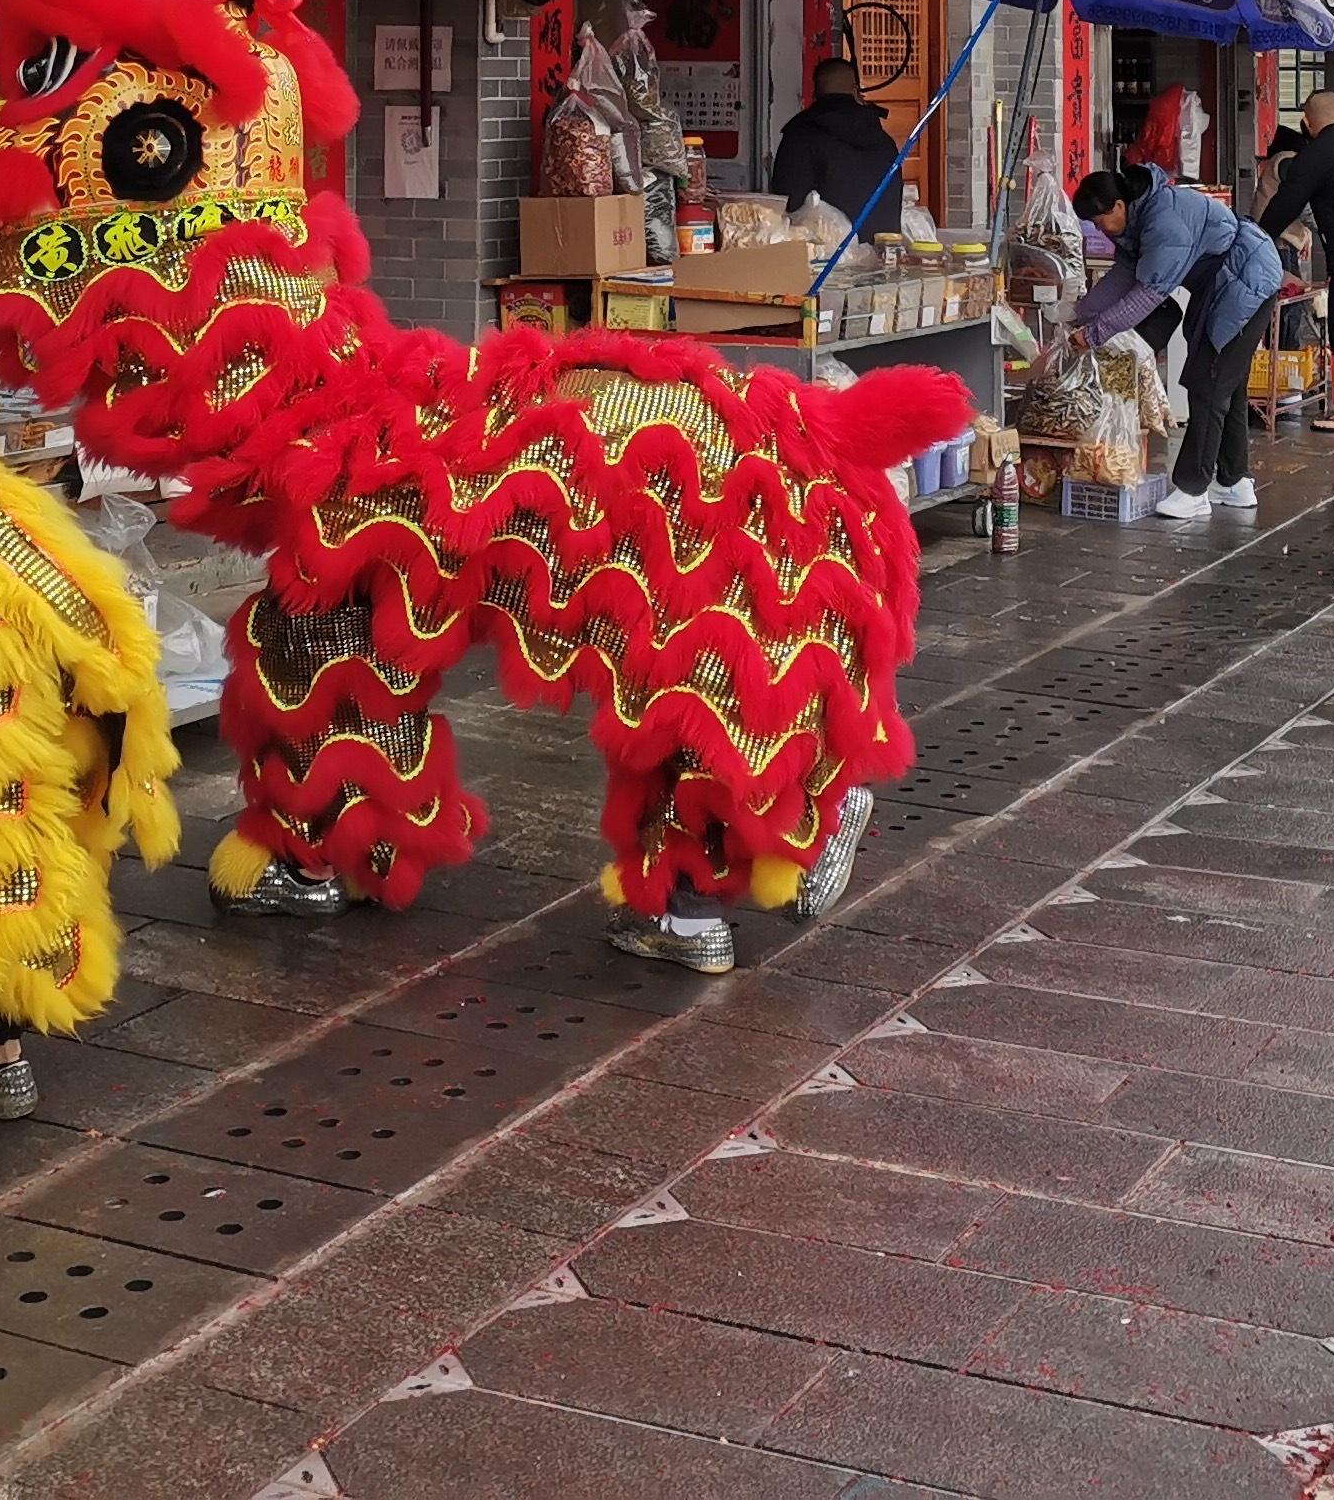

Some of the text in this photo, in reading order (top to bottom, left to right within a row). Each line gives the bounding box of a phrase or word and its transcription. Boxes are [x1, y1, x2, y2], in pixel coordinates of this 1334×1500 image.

[385, 37, 443, 52] 请佩戴罩
[384, 56, 443, 71] 配合测温
